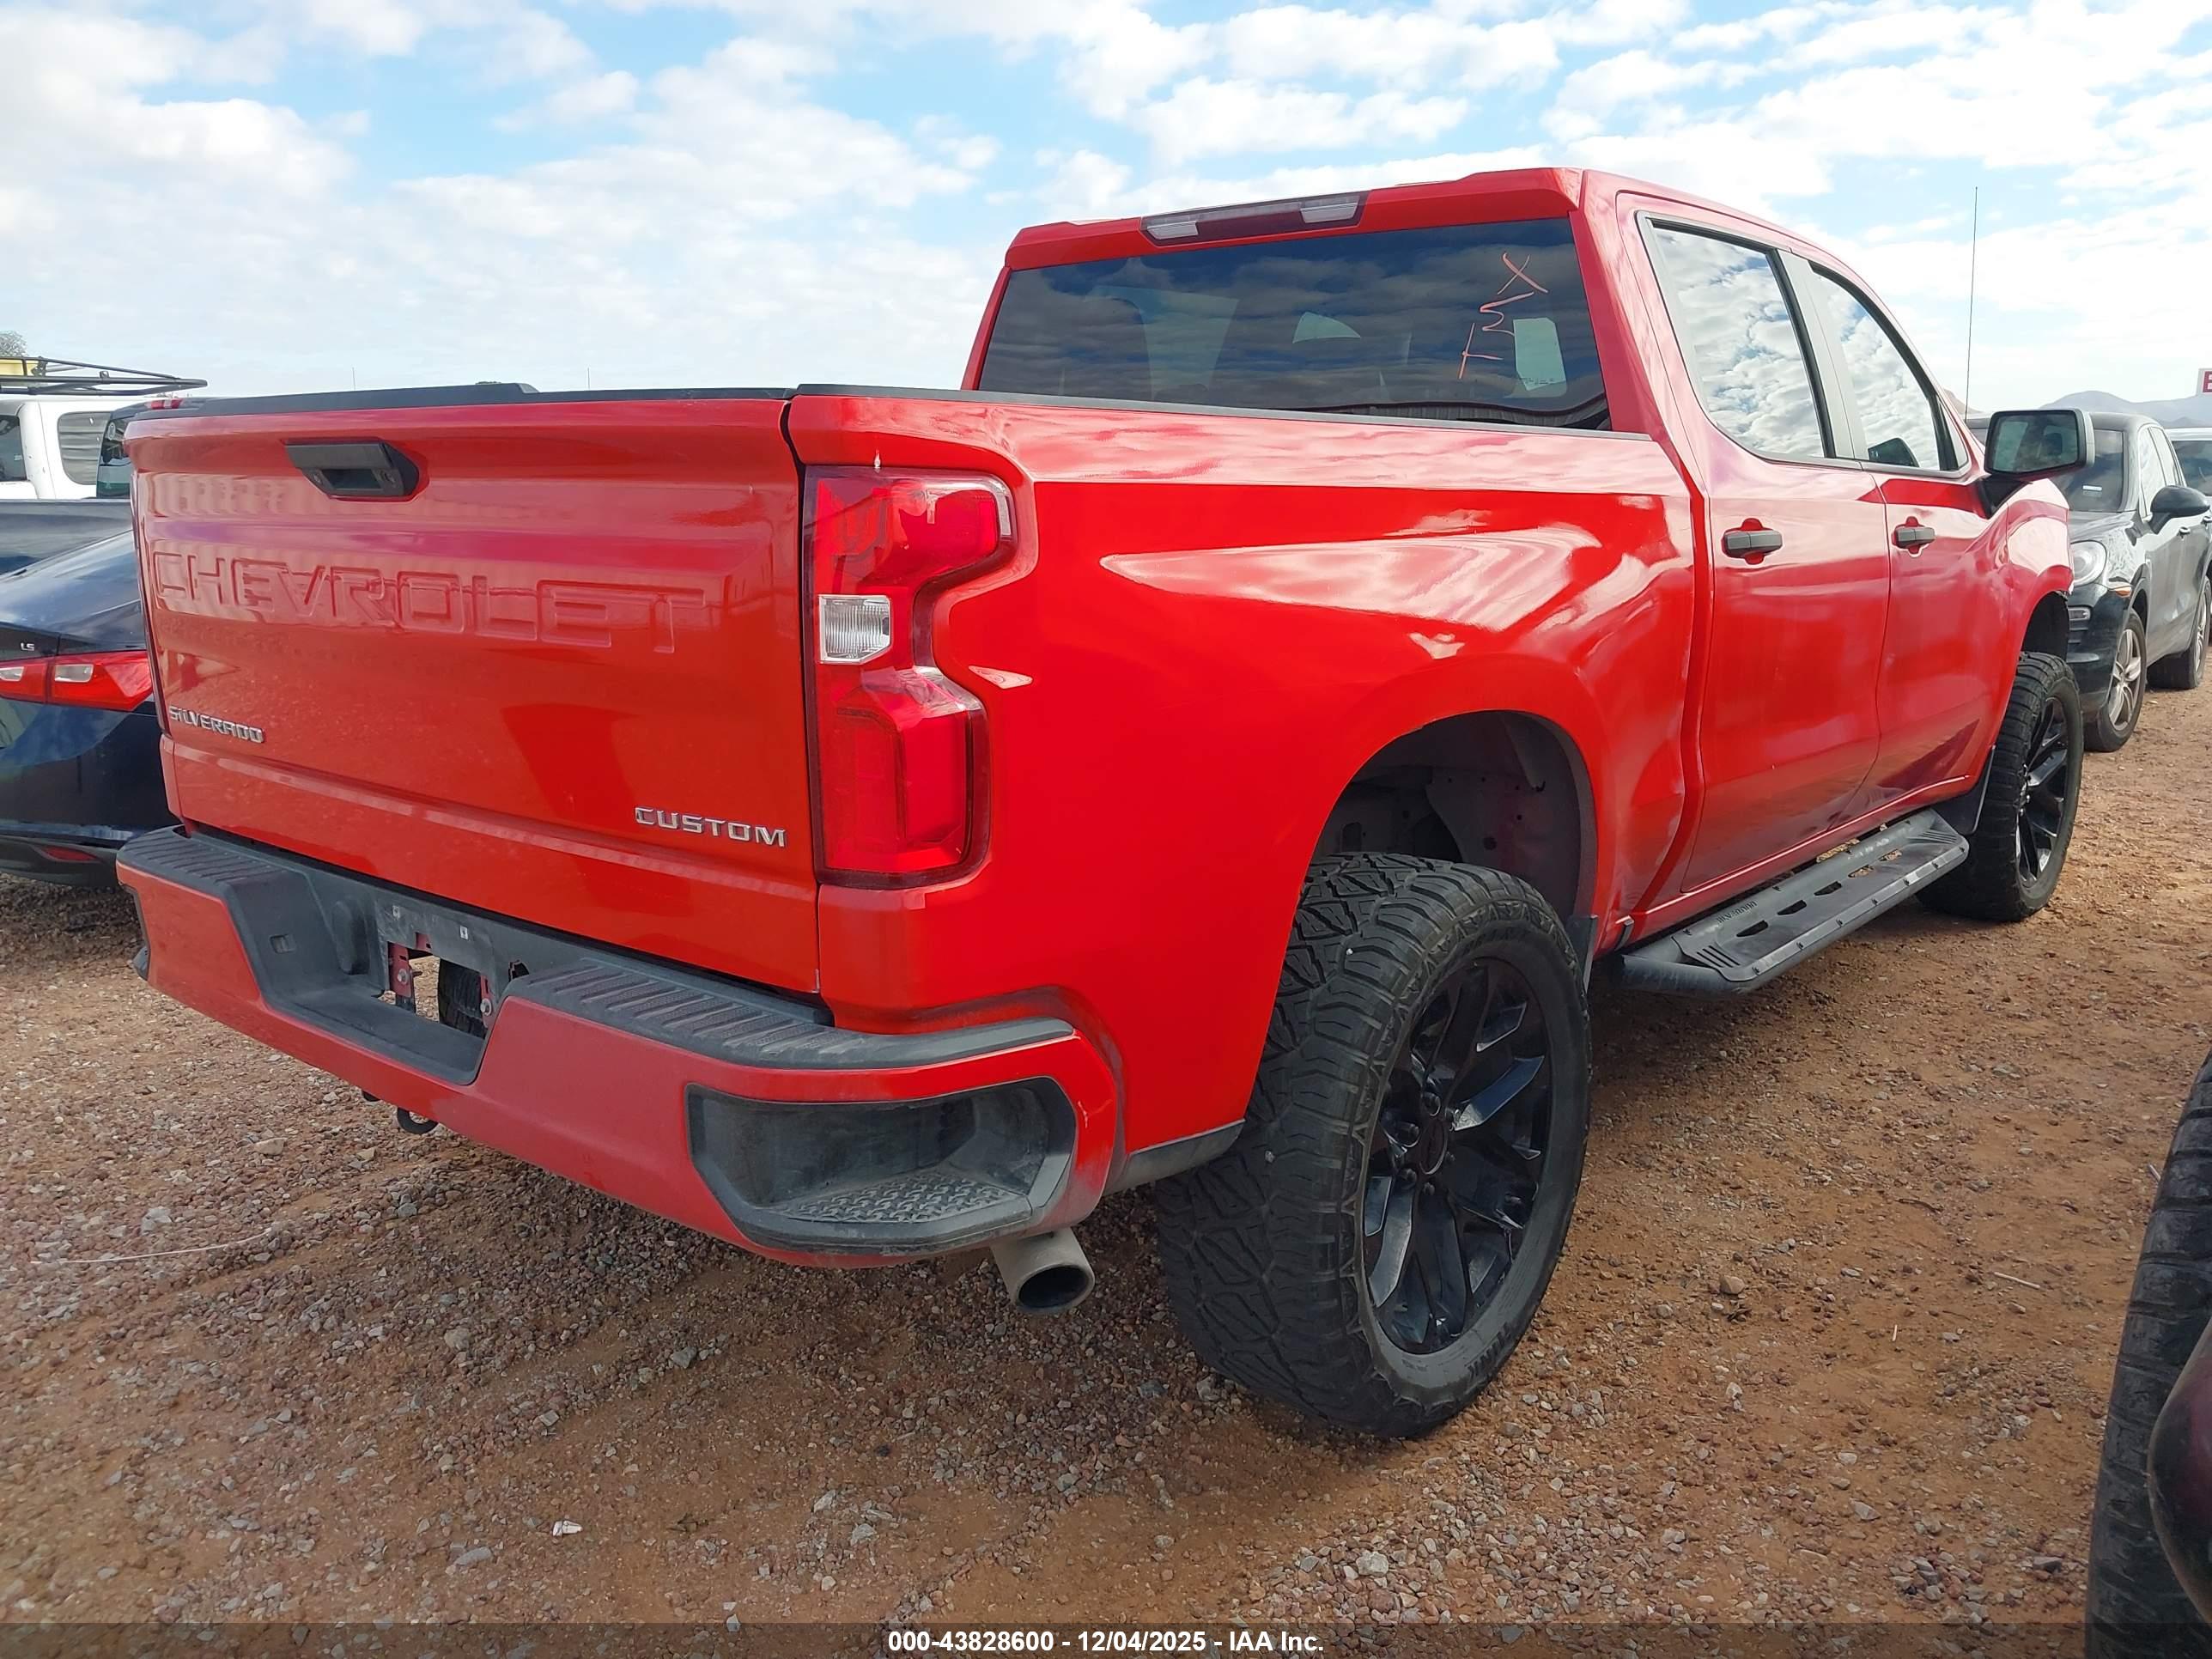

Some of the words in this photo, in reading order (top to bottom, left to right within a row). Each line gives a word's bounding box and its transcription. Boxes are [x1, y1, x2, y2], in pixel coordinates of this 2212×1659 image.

[152, 552, 705, 653] CHEVROLET
[20, 642, 35, 652] LS
[168, 705, 265, 744] SILVERADO
[634, 805, 786, 848] CUSTOM
